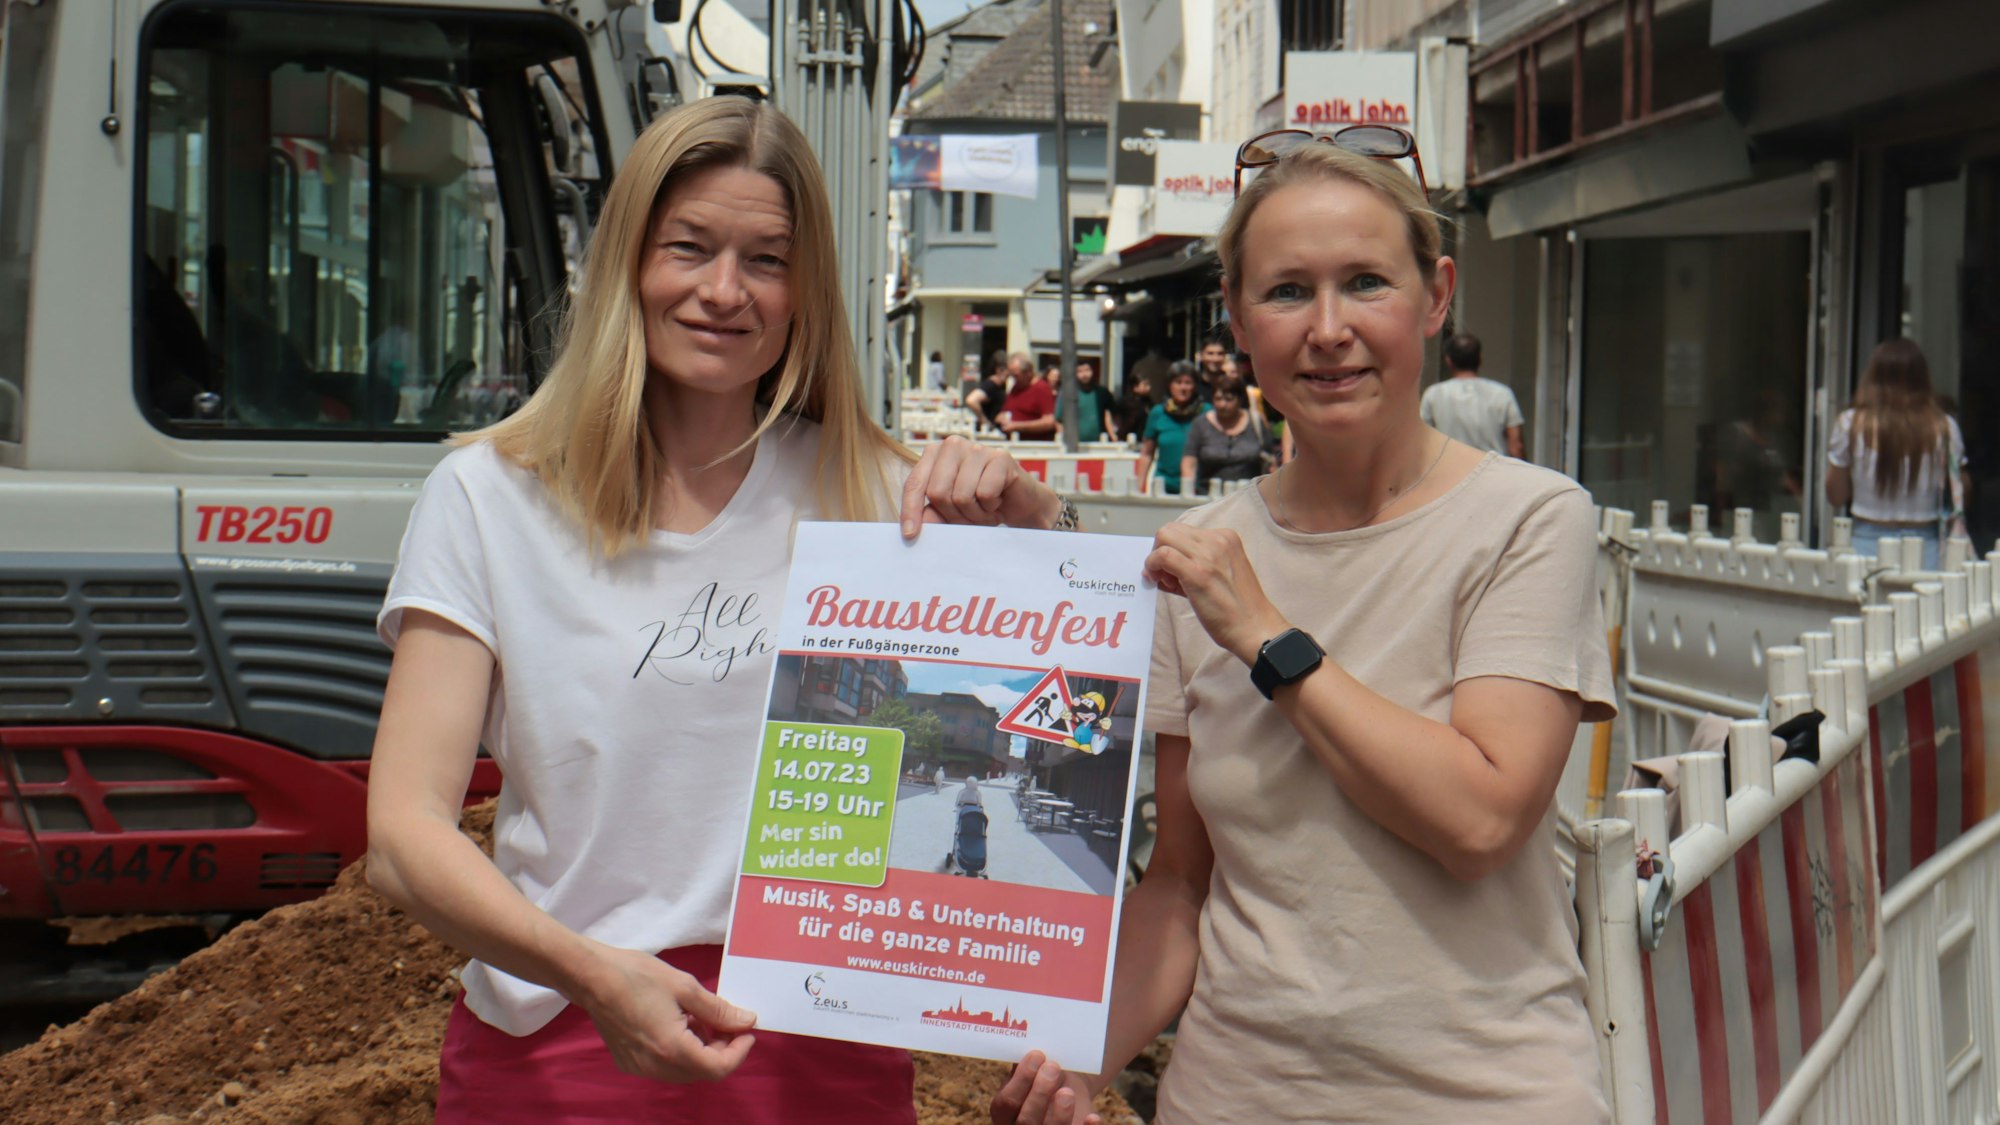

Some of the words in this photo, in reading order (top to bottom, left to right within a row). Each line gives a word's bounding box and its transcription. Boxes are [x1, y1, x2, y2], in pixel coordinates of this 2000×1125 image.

[1296, 99, 1350, 127] optik
[1360, 98, 1407, 124] john
[1163, 175, 1204, 195] optik
[1207, 175, 1235, 196] joh
[195, 505, 333, 544] TB250
[1069, 579, 1135, 593] euskirchen
[674, 582, 761, 647] All
[806, 585, 1128, 655] Baustellenfest
[633, 620, 777, 685] Righ
[802, 636, 815, 647] in
[820, 637, 843, 649] der
[847, 638, 960, 657] Fußgängerzone
[778, 729, 867, 758] Freitag
[773, 759, 871, 785] 14.07.23
[768, 789, 829, 812] 15-19
[837, 794, 885, 817] Uhr
[760, 823, 804, 843] Mer
[809, 821, 843, 841] sin
[54, 843, 218, 886] 84476
[759, 847, 838, 869] widder
[844, 846, 881, 866] do!
[762, 885, 836, 913] Musik,
[842, 893, 902, 919] Spaß
[908, 900, 925, 921] &
[933, 904, 1085, 947] Unterhaltung
[798, 916, 832, 938] für
[838, 921, 875, 943] die
[880, 929, 951, 954] ganze
[957, 937, 1041, 966] Familie
[847, 955, 986, 985] www.euskirchen.de
[813, 996, 848, 1010] z.eu.s
[920, 1017, 971, 1031] INNENSTADT
[973, 1025, 1028, 1038] EUSKIRCHEN
